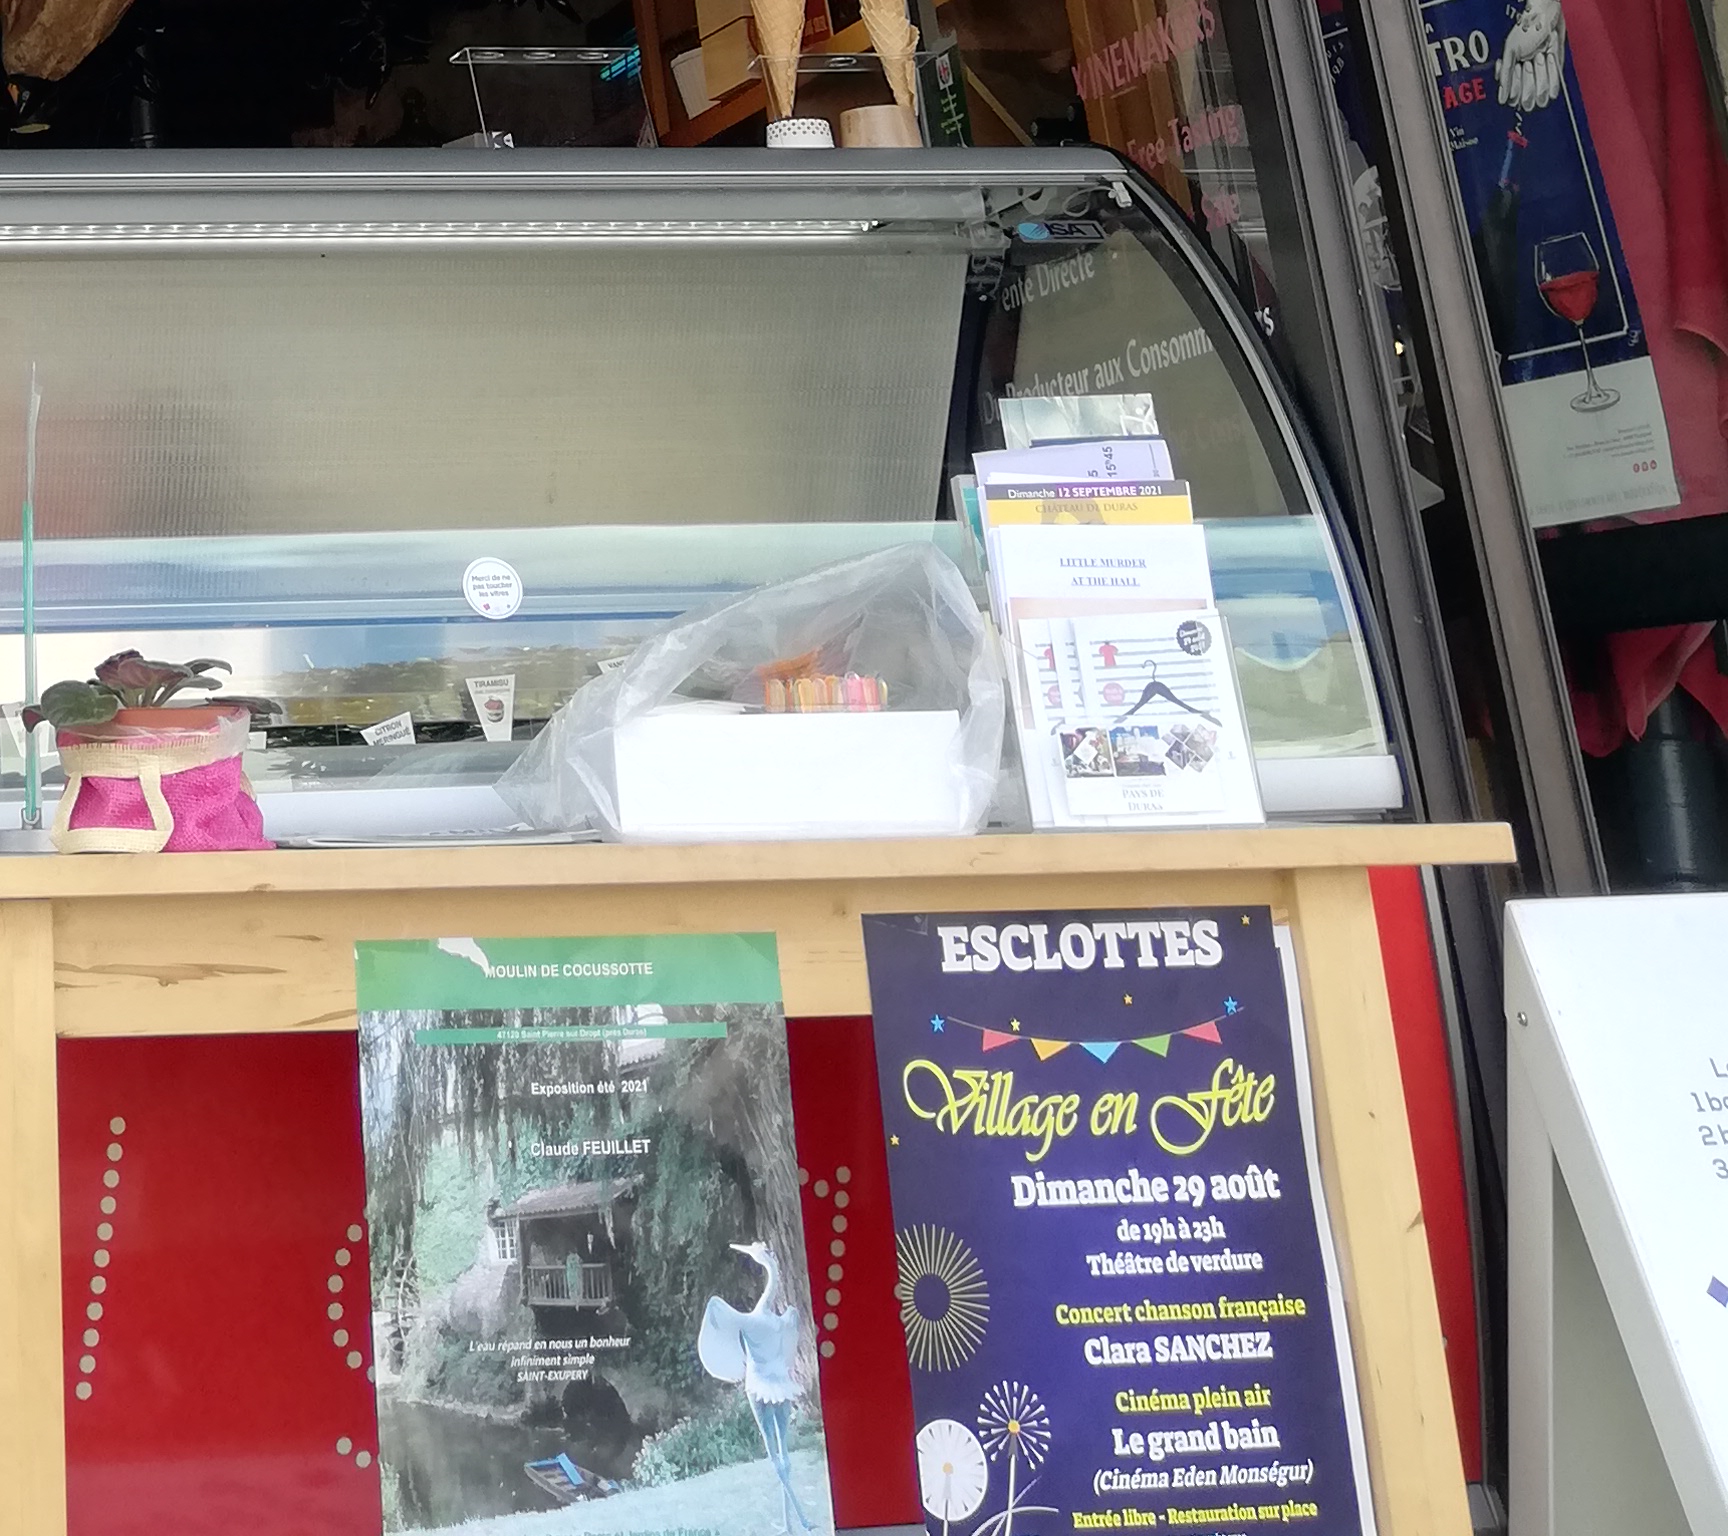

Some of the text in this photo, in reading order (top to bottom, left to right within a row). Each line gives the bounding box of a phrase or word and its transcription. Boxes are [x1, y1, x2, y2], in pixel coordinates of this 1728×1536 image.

[1427, 30, 1489, 76] TRO
[1444, 79, 1486, 110] AGE
[1036, 250, 1095, 297] Directe
[1094, 357, 1123, 390] aux
[1007, 485, 1162, 500] Dimanche 12 SEPTEMBRE 2021
[1103, 501, 1138, 512] DURAS
[1060, 558, 1147, 568] LITTLE MURDER
[375, 719, 402, 735] CITRON
[1122, 788, 1165, 799] PAYS DE
[937, 919, 1224, 973] ESCLOTTES
[485, 961, 654, 979] MOULIN DE COCUSSOTTE
[521, 1030, 541, 1039] Saint
[541, 1030, 564, 1039] Pierre
[531, 1079, 647, 1097] Exposition été 2021
[903, 1059, 1080, 1162] Village
[1090, 1091, 1140, 1136] en
[530, 1138, 651, 1157] Claude FEUILLET
[1010, 1165, 1281, 1209] Dimanche 29 août
[1117, 1216, 1226, 1244] de 19h à 23h
[1087, 1250, 1263, 1276] Théâtre de verdure
[1055, 1293, 1306, 1325] Concert chanson française
[497, 1339, 532, 1353] répand
[534, 1341, 547, 1350] en
[548, 1340, 573, 1350] nous
[574, 1339, 588, 1349] un
[589, 1335, 631, 1348] bonheur
[1084, 1331, 1274, 1365] Clara SANCHEZ
[510, 1353, 595, 1368] infiniment simple
[1115, 1383, 1272, 1415] Cinéma plein air
[1111, 1417, 1280, 1461] Le grand bain
[1092, 1458, 1314, 1496] (Cinéma Eden Monségur)
[1072, 1499, 1318, 1528] Entrée libre Restauration sur place
